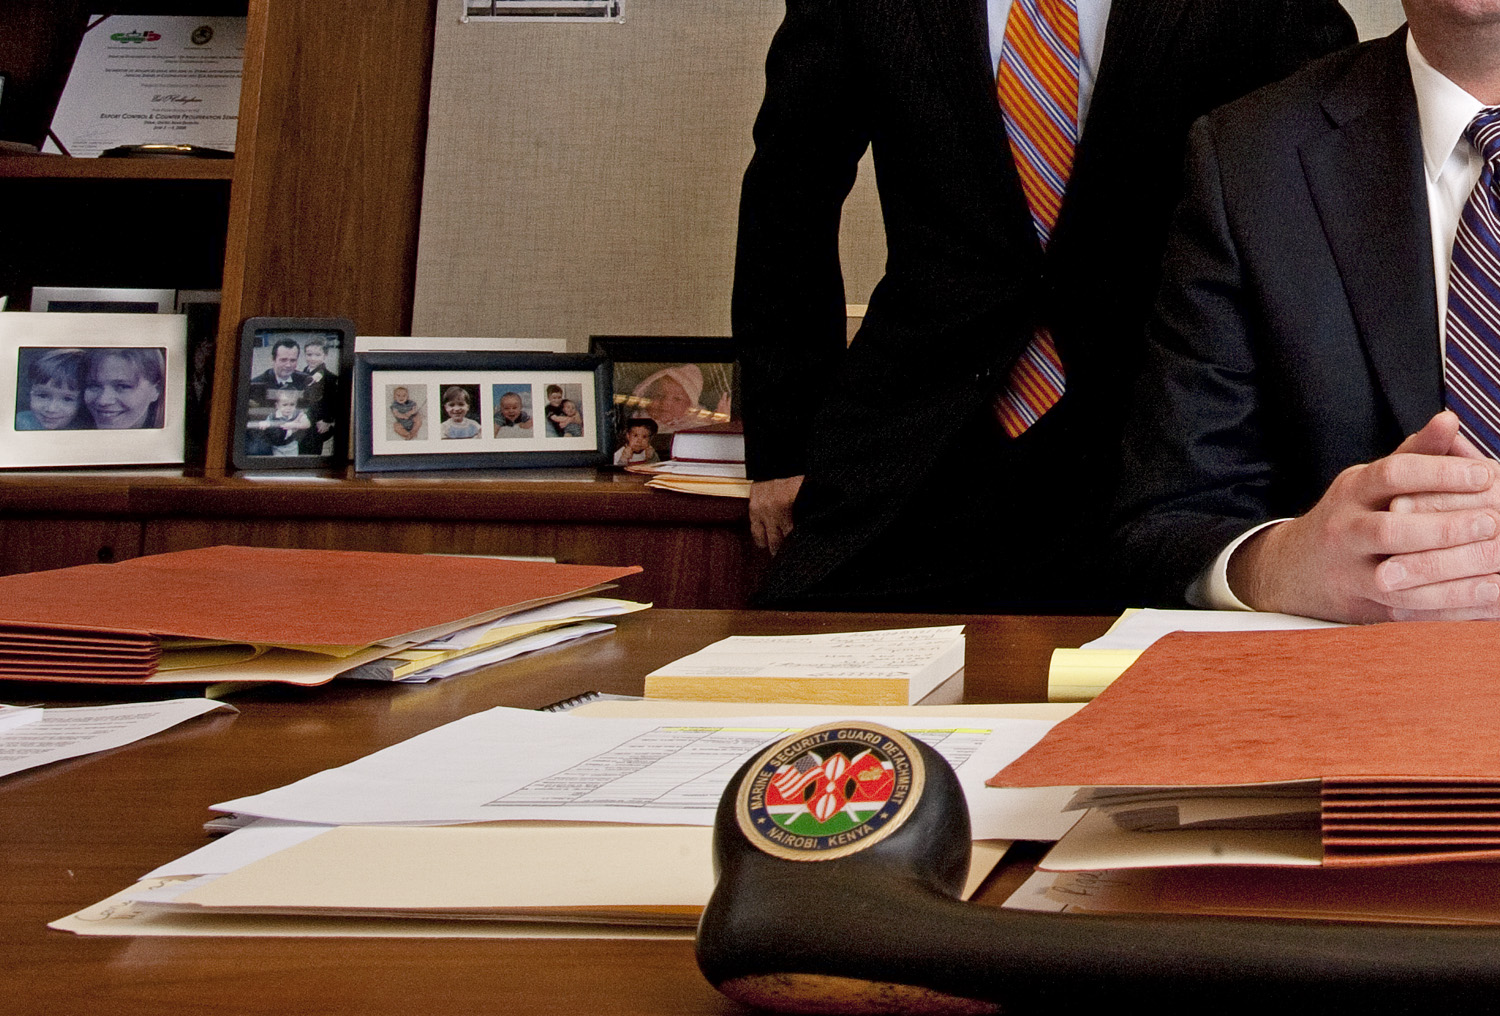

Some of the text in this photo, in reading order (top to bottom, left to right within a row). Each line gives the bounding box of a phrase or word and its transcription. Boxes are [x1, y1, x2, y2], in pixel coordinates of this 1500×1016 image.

[750, 729, 912, 810] MARINE SECURITY GUARD DETACHMENT
[828, 824, 874, 847] KENYA
